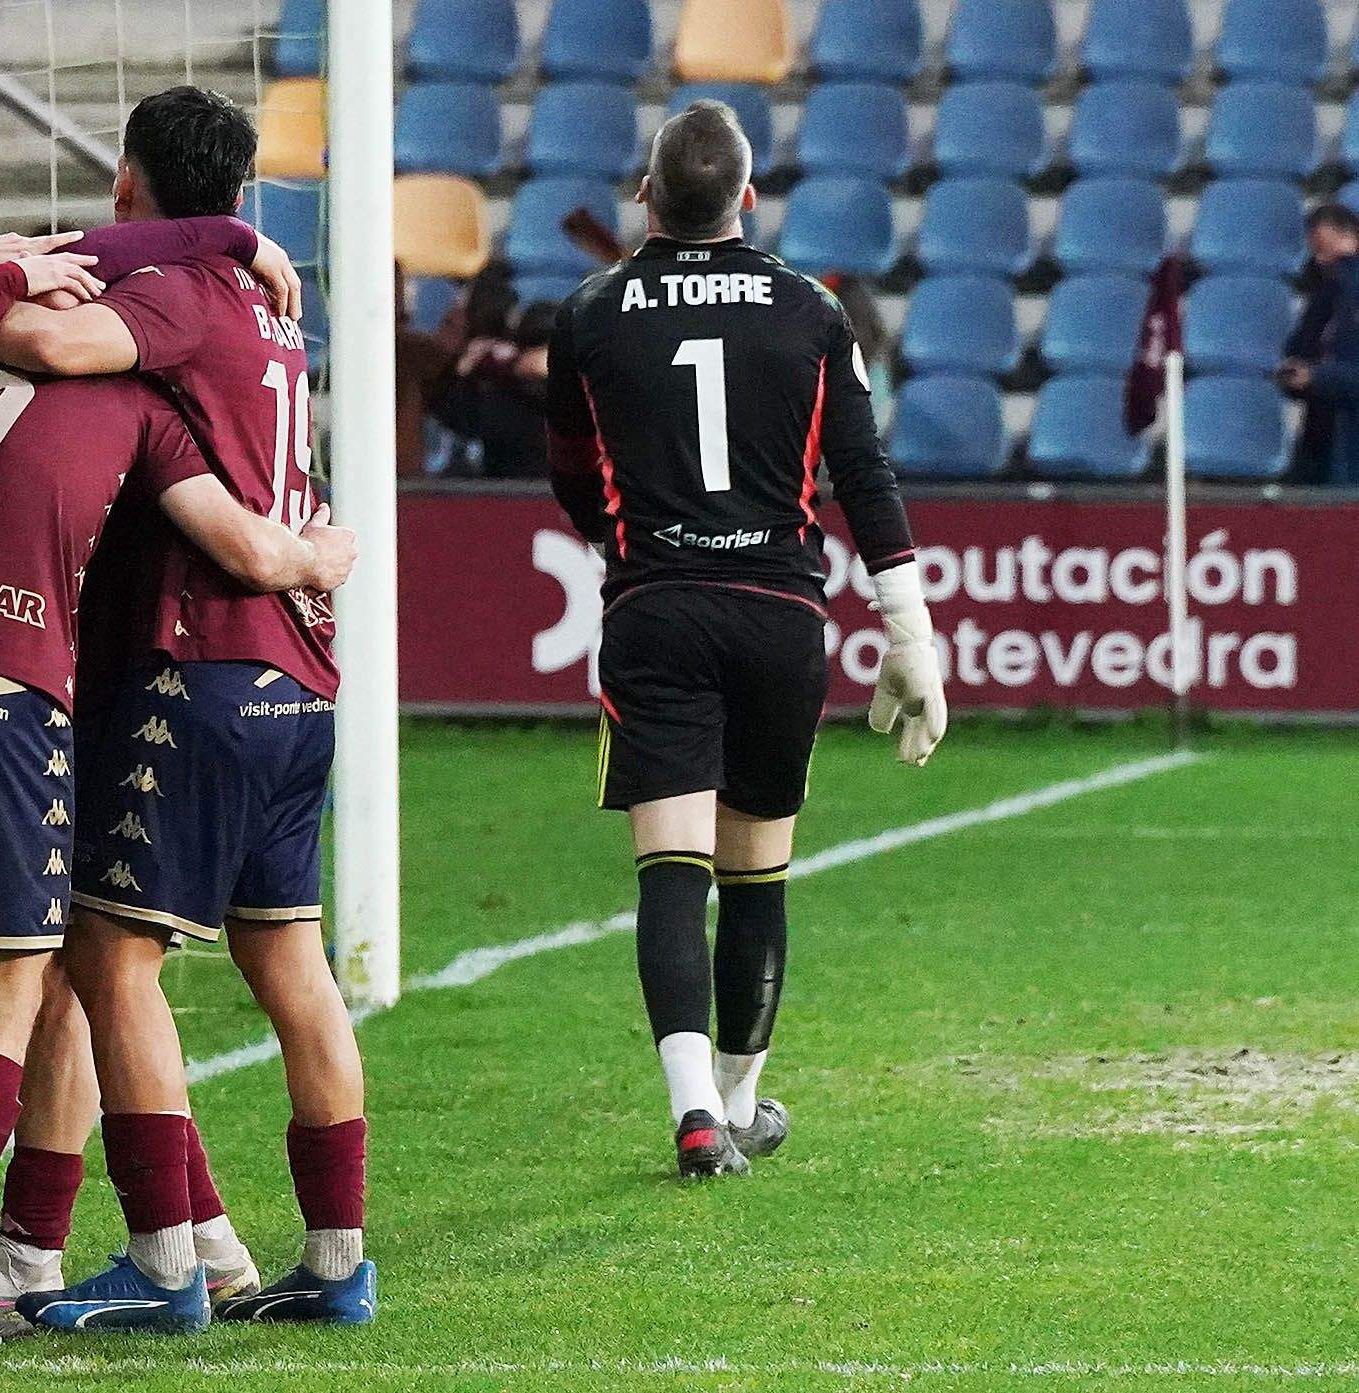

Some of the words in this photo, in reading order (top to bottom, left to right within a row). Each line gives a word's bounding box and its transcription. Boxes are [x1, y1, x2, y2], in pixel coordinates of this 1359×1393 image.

[671, 338, 731, 492] 1
[823, 528, 1297, 604] putacón
[824, 617, 1297, 690] otevedra
